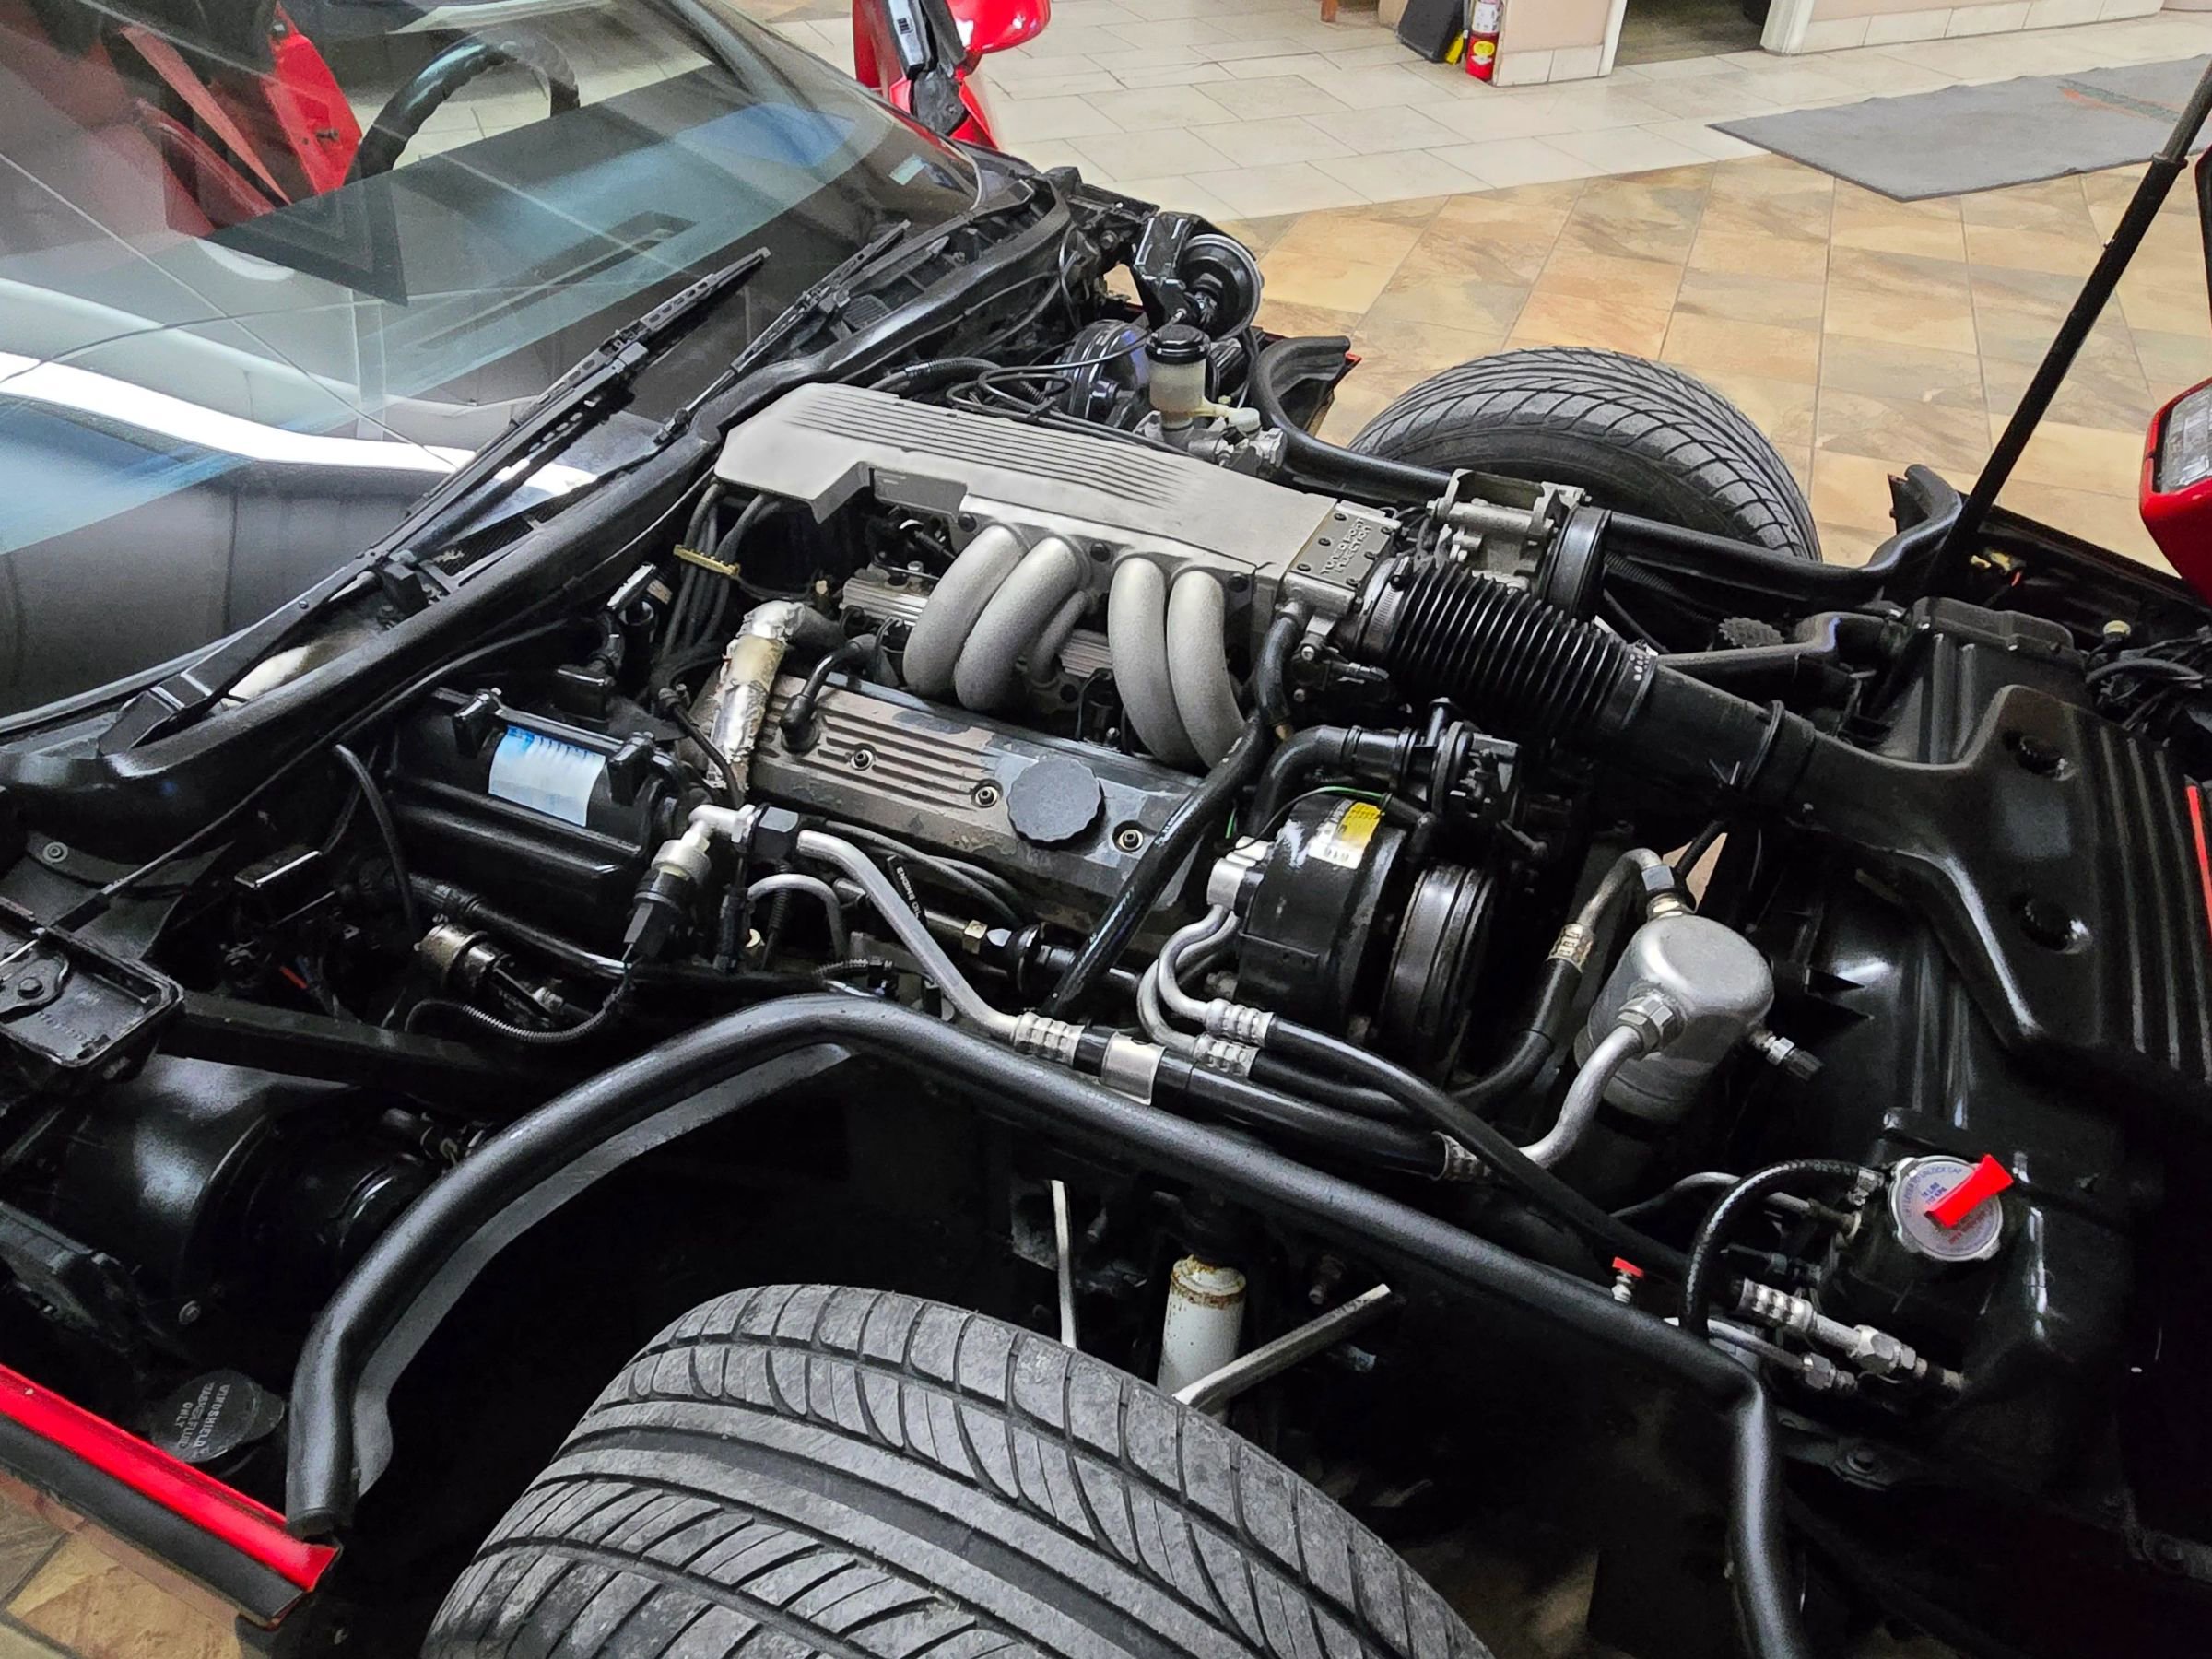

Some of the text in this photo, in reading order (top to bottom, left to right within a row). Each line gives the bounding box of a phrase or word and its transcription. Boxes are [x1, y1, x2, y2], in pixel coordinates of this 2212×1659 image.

[1334, 524, 1371, 572] INJECTION
[896, 866, 922, 920] ENGINE OIL
[175, 1402, 194, 1428] ONLY
[193, 1384, 230, 1448] WINDSHIELD
